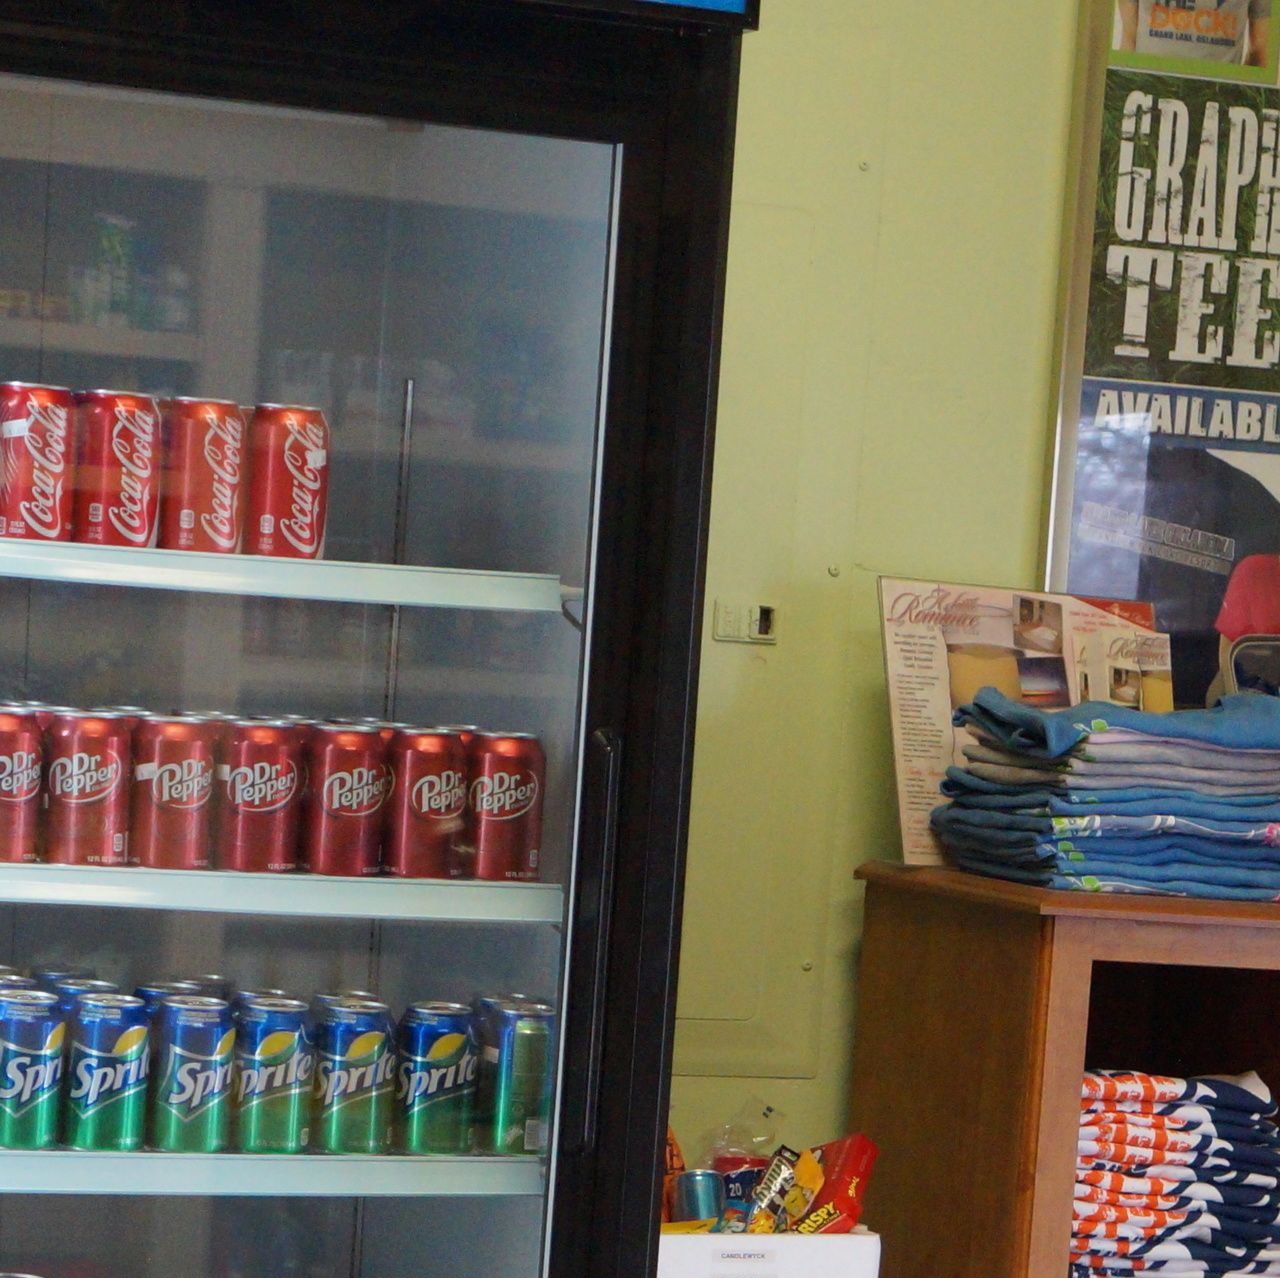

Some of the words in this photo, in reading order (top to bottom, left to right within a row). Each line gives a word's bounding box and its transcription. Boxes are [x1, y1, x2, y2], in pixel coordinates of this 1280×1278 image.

[19, 394, 69, 539] Coca-Cola
[108, 401, 155, 544] Coca-Cola
[201, 407, 244, 549] Coca-Cola
[13, 751, 35, 772] Dr
[50, 756, 118, 795] Pepper
[72, 752, 101, 775] Dr
[179, 759, 205, 782] Dr
[254, 762, 281, 784] Dr
[230, 765, 296, 805] Pepper
[353, 767, 377, 790] Dr
[441, 770, 462, 792] Dr
[495, 771, 521, 793] Dr
[472, 776, 536, 814] Pepper
[170, 1059, 234, 1108] Spri
[729, 1183, 742, 1197] 20
[796, 1201, 836, 1234] RISPY
